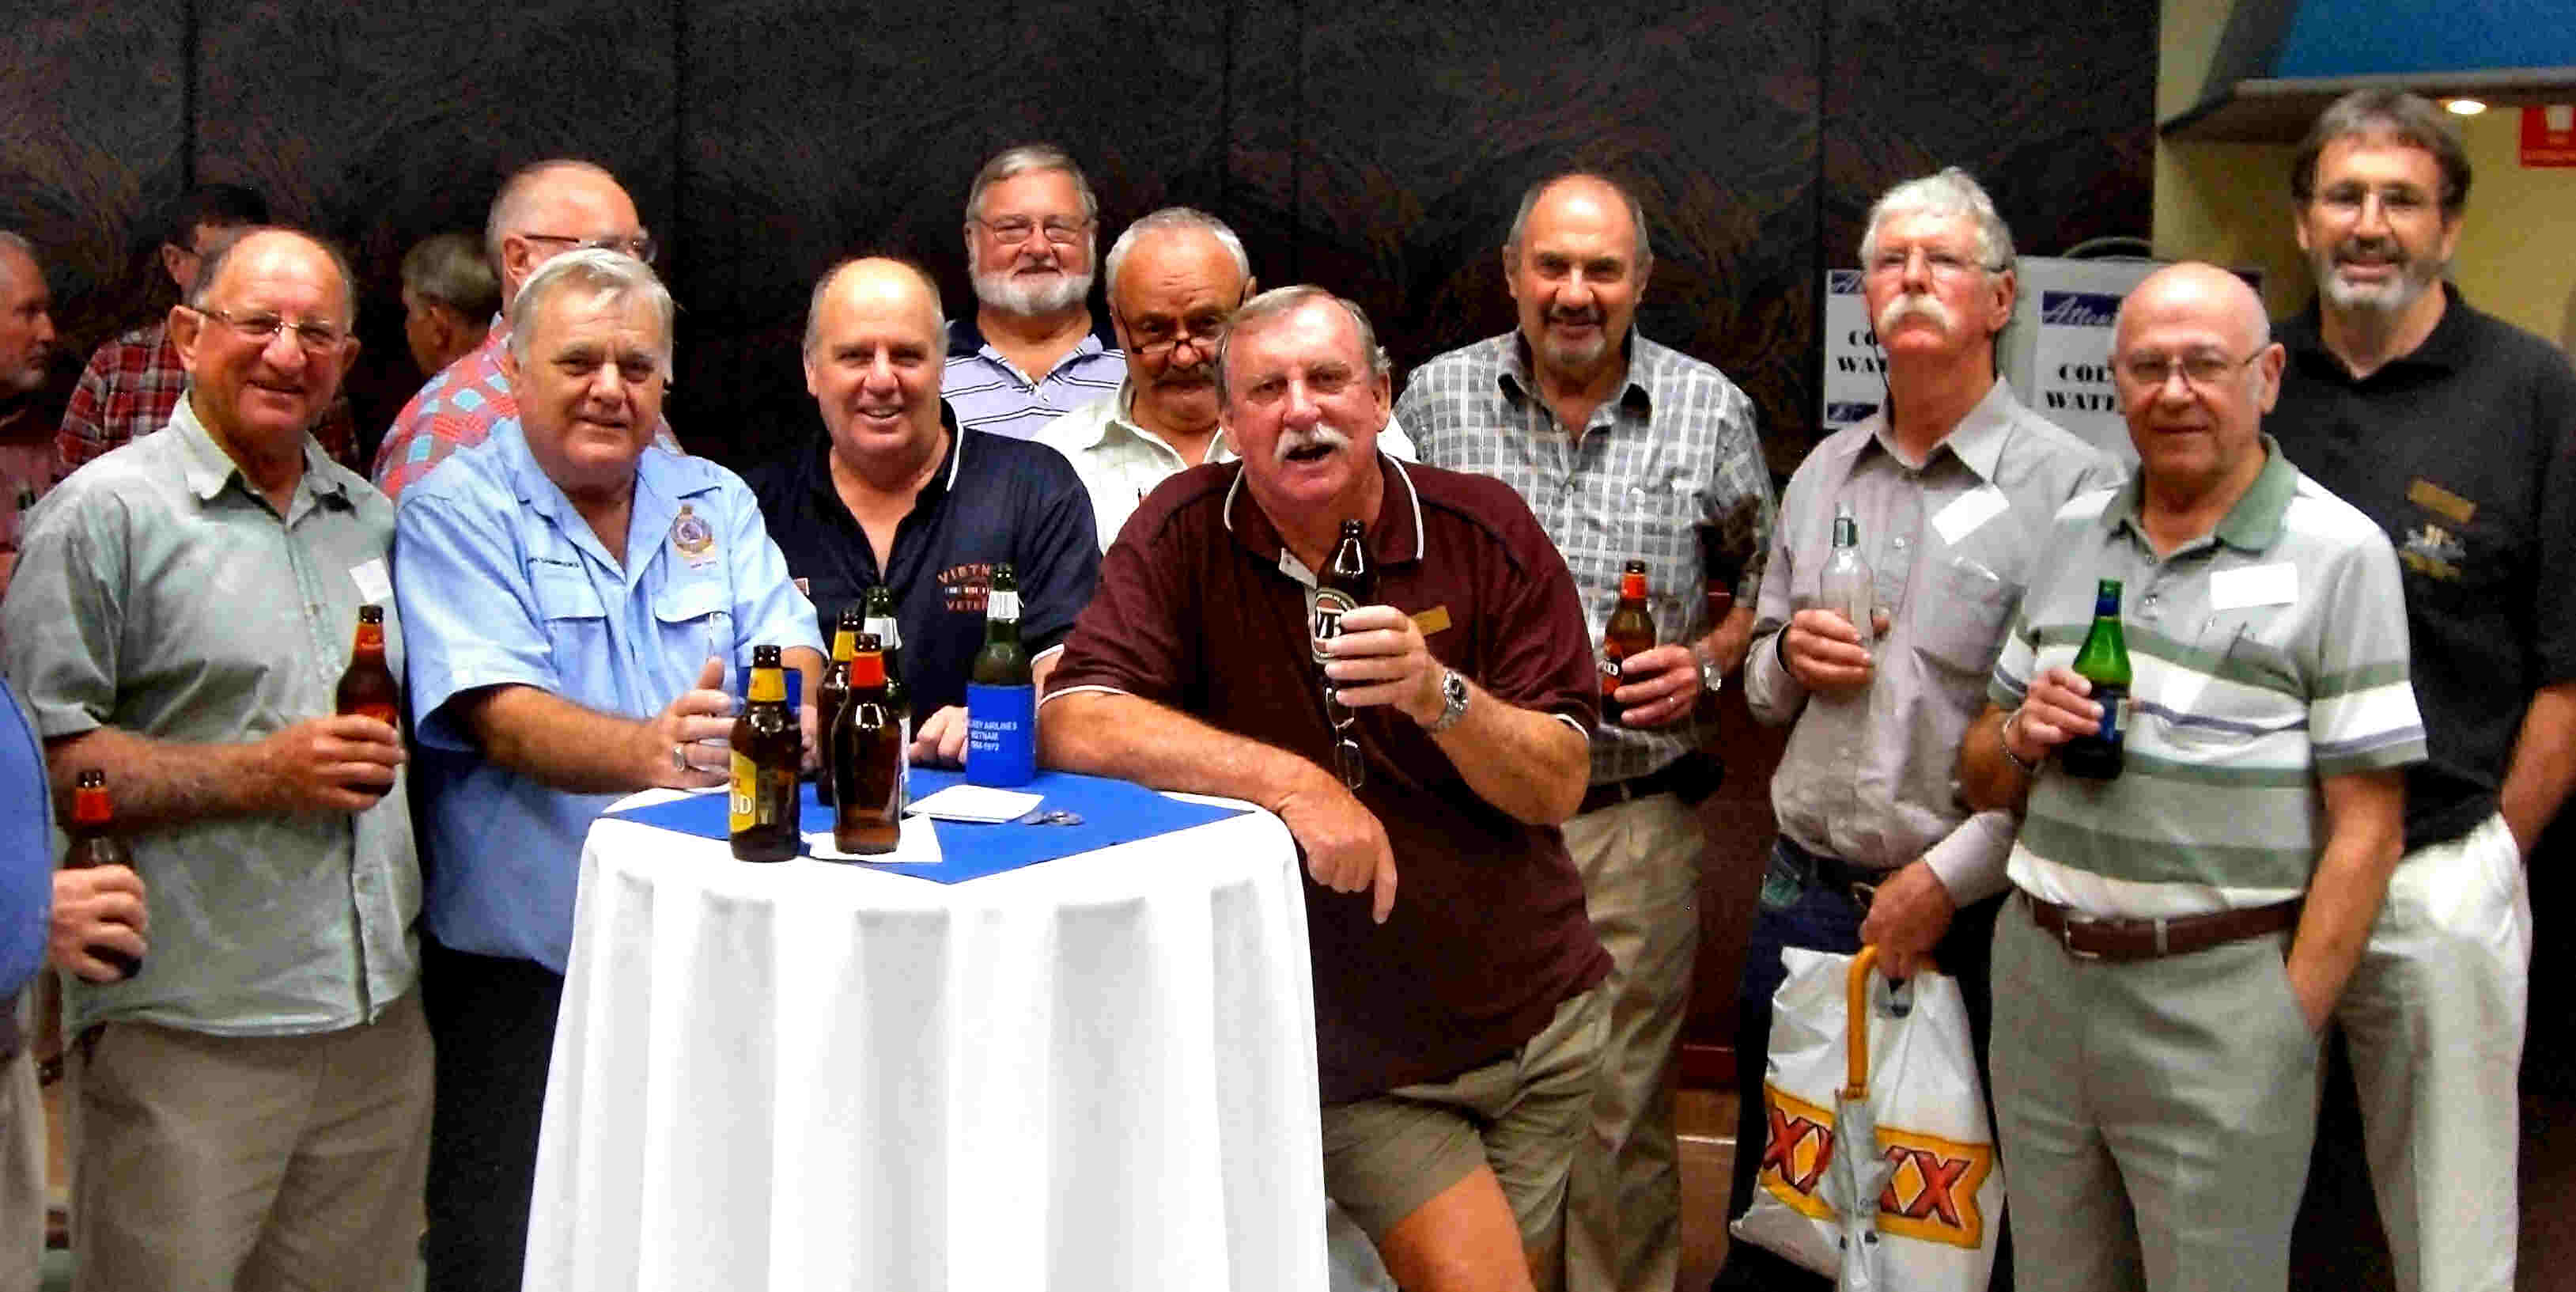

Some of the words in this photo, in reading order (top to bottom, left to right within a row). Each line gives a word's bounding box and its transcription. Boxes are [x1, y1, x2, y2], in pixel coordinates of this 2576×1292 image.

[1848, 330, 1878, 348] CO
[1835, 356, 1889, 373] WAT
[2058, 362, 2112, 382] COL
[936, 563, 991, 583] VIETN
